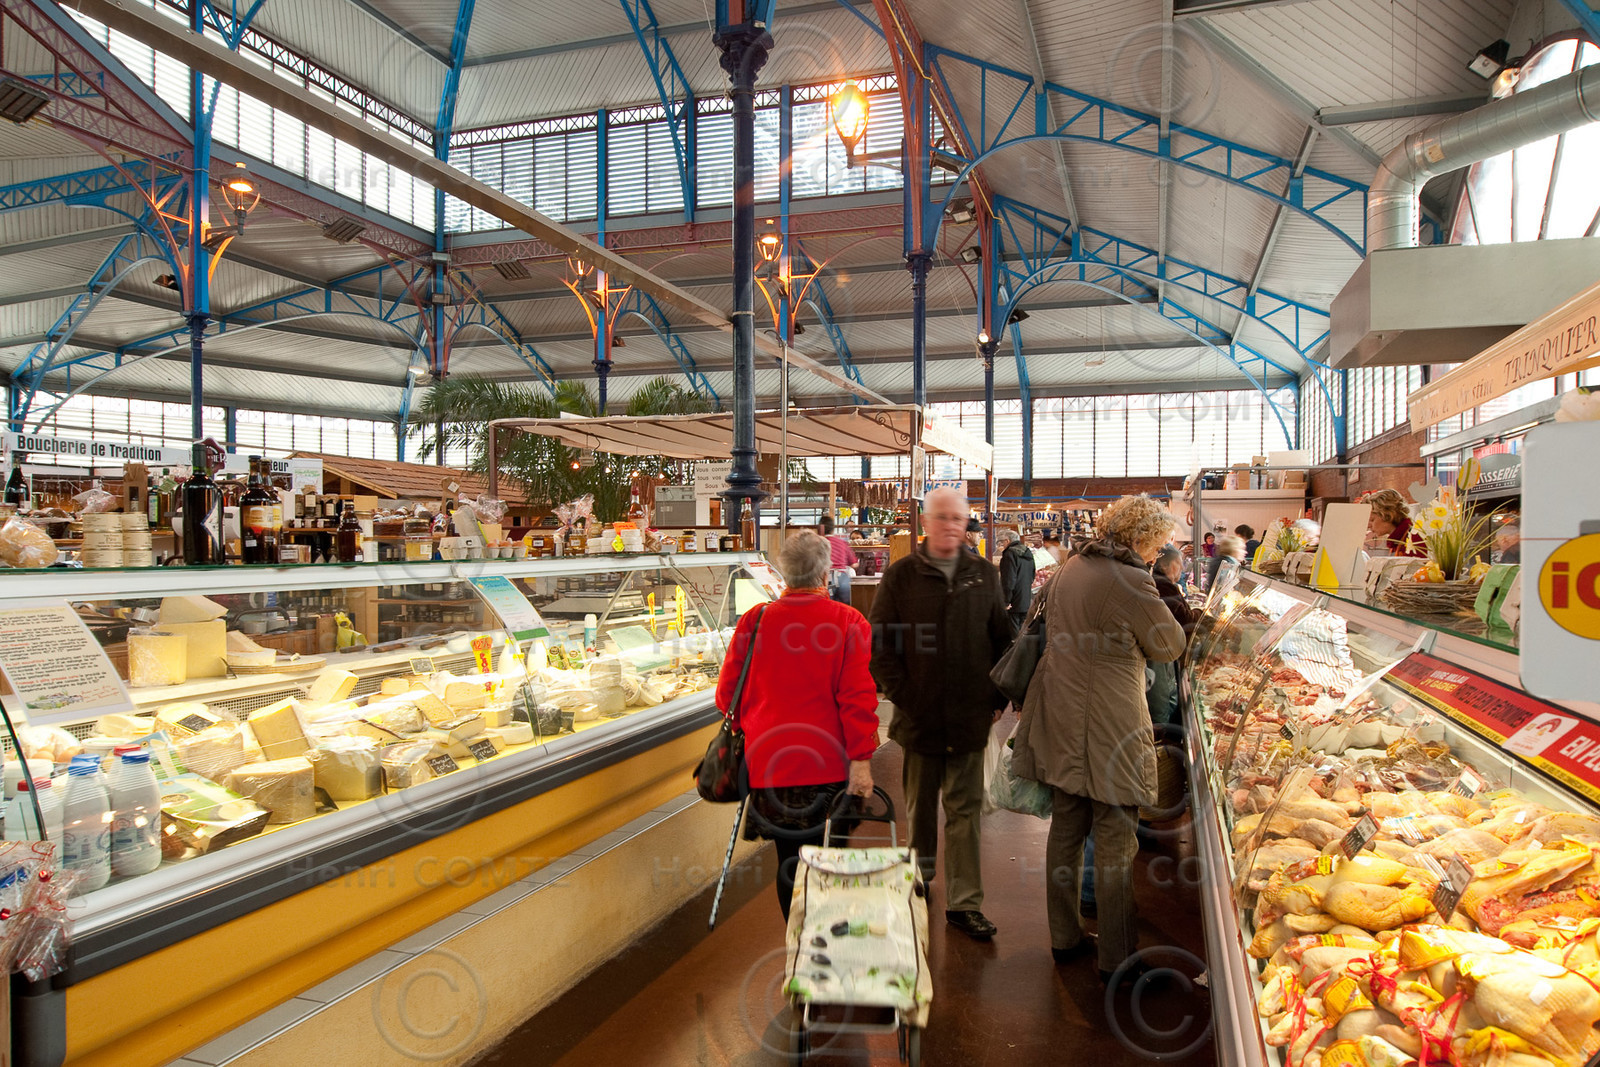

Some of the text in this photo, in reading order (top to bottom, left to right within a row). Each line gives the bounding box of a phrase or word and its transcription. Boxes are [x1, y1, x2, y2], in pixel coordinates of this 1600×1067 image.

[1504, 316, 1598, 386] TRINQUIER
[17, 435, 162, 461] Boucherie de Tradition
[1559, 735, 1596, 759] EN
